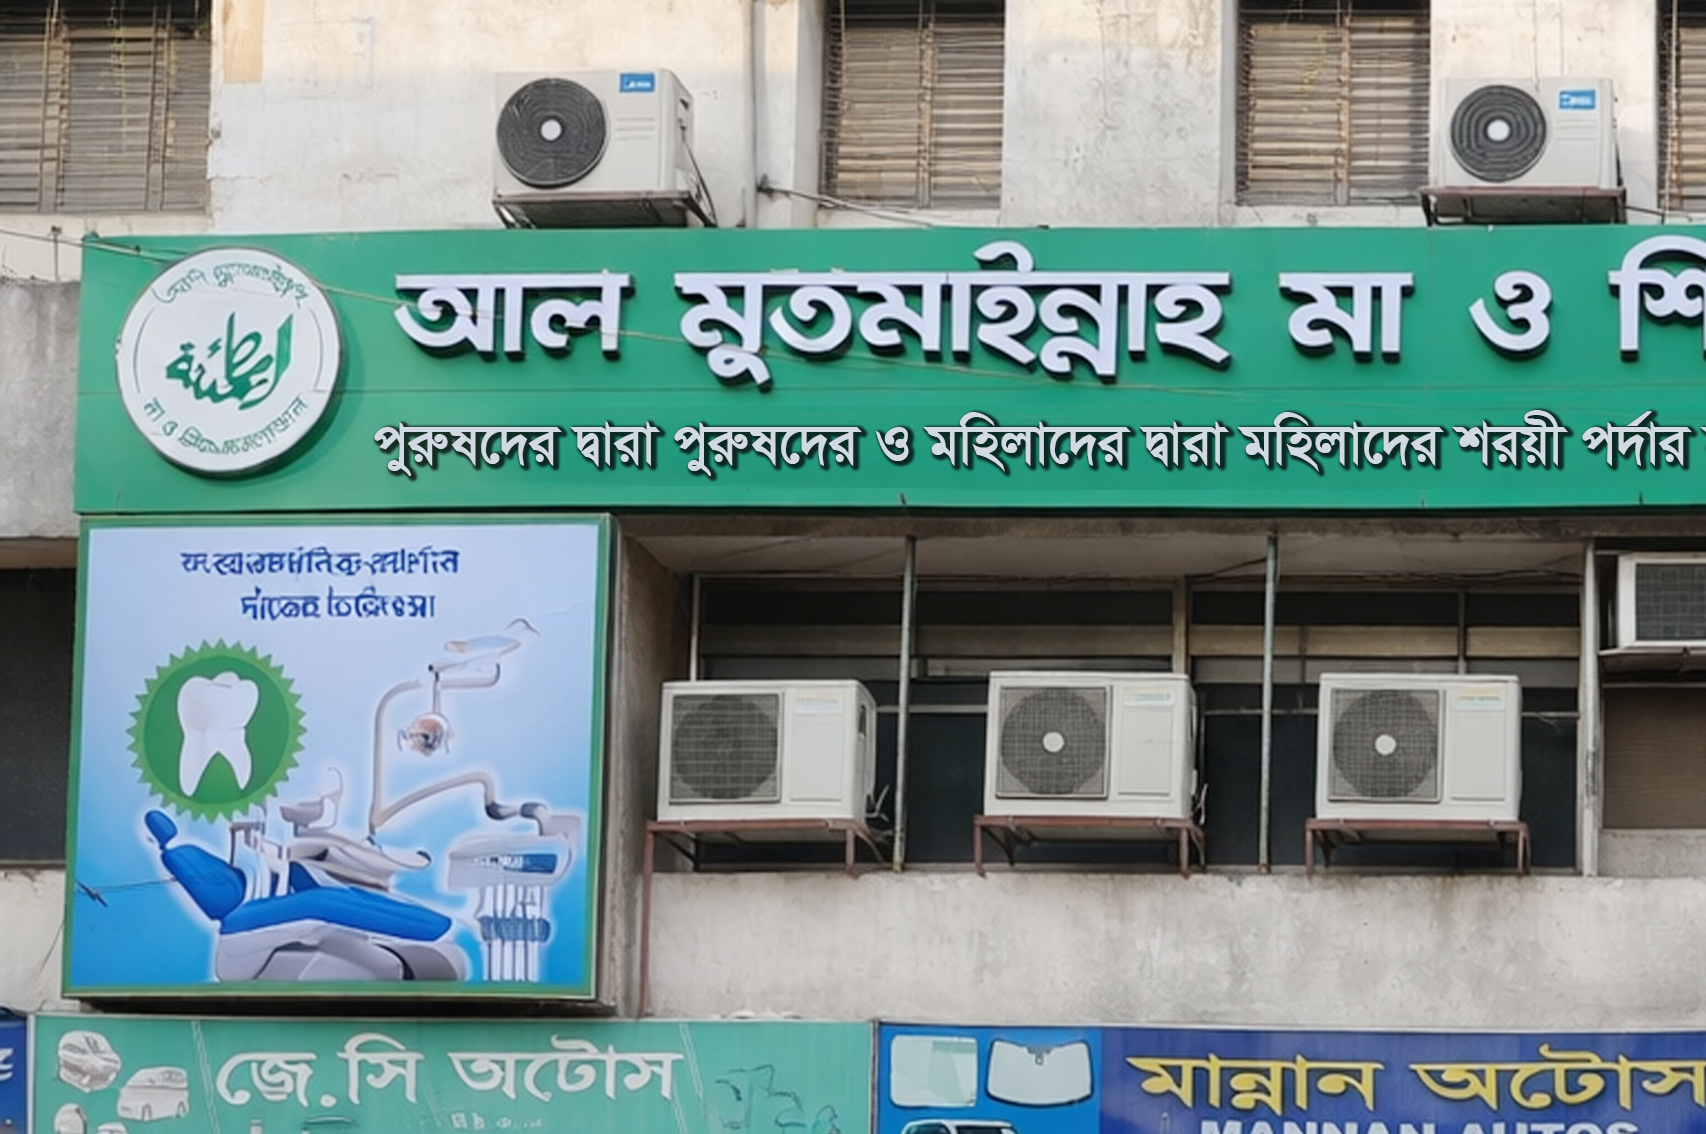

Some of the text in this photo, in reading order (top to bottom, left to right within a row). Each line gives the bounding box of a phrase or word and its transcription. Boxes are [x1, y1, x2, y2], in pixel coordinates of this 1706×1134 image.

[393, 271, 634, 356] আল
[674, 240, 1232, 386] মুতমাইন্নাহ
[1279, 272, 1414, 356] মা
[1468, 270, 1553, 355] ও
[375, 420, 561, 477] পুরুষদের
[572, 420, 659, 470] দ্বারা
[673, 421, 861, 477] পুরুষদের
[875, 426, 912, 465] ও
[924, 411, 1129, 473] মহিলাদের
[1140, 420, 1227, 469] দ্বারা
[1238, 411, 1442, 473] মহিলাদের
[1581, 410, 1692, 468] পর্দার
[448, 1034, 684, 1102] অটোস
[1125, 1053, 1386, 1117] মান্নান
